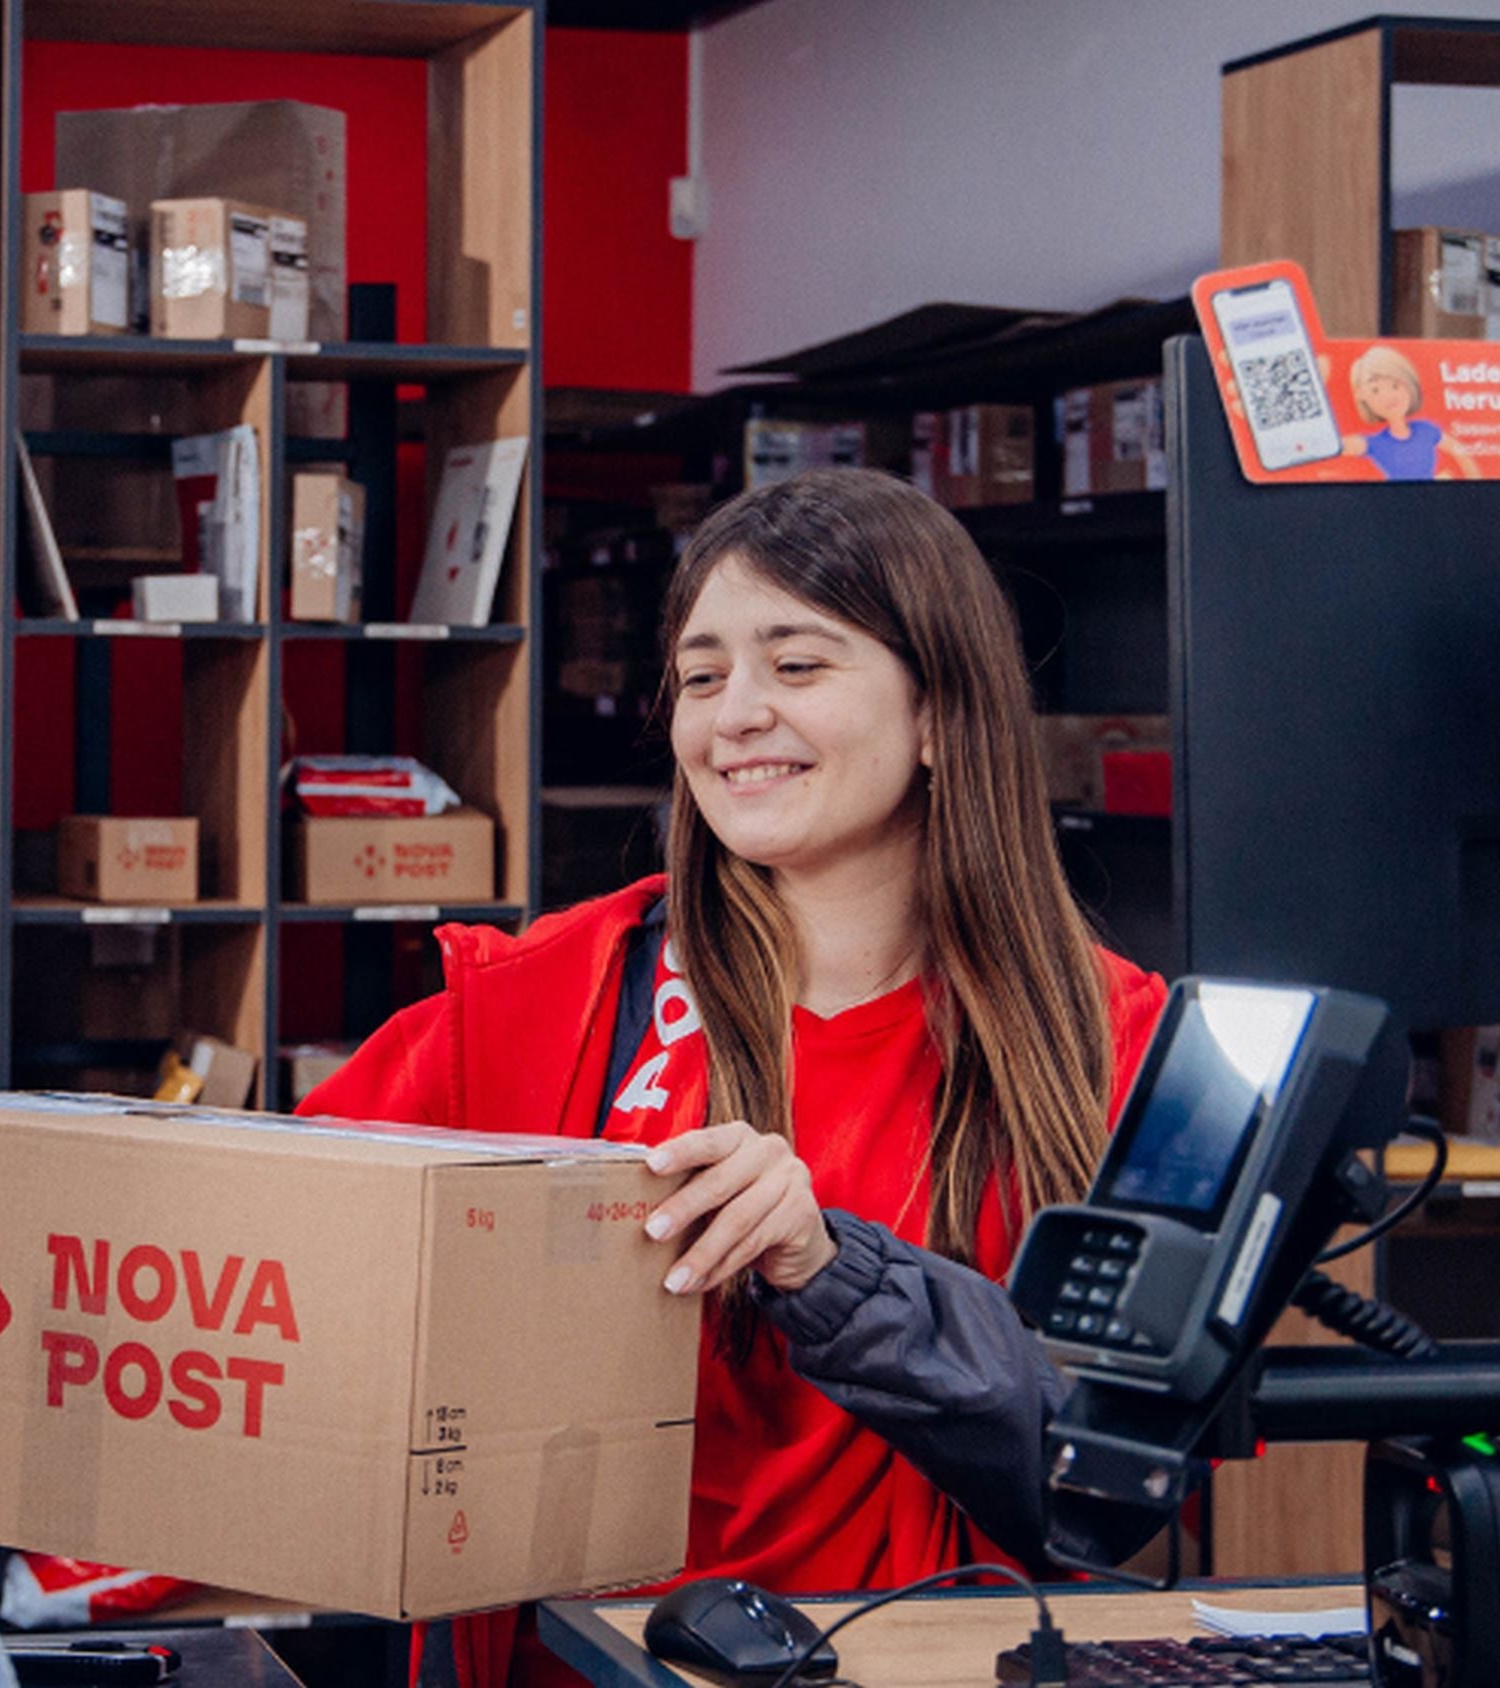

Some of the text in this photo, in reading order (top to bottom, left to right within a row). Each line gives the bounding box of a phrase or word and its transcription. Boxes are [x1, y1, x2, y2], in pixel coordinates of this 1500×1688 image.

[393, 843, 453, 858] NOVA
[393, 863, 449, 879] POST
[466, 1207, 495, 1232] 5 kg
[47, 1232, 300, 1343] NOVA
[41, 1330, 285, 1438] POST
[438, 1426, 462, 1443] 3 kg
[444, 1479, 458, 1496] kg
